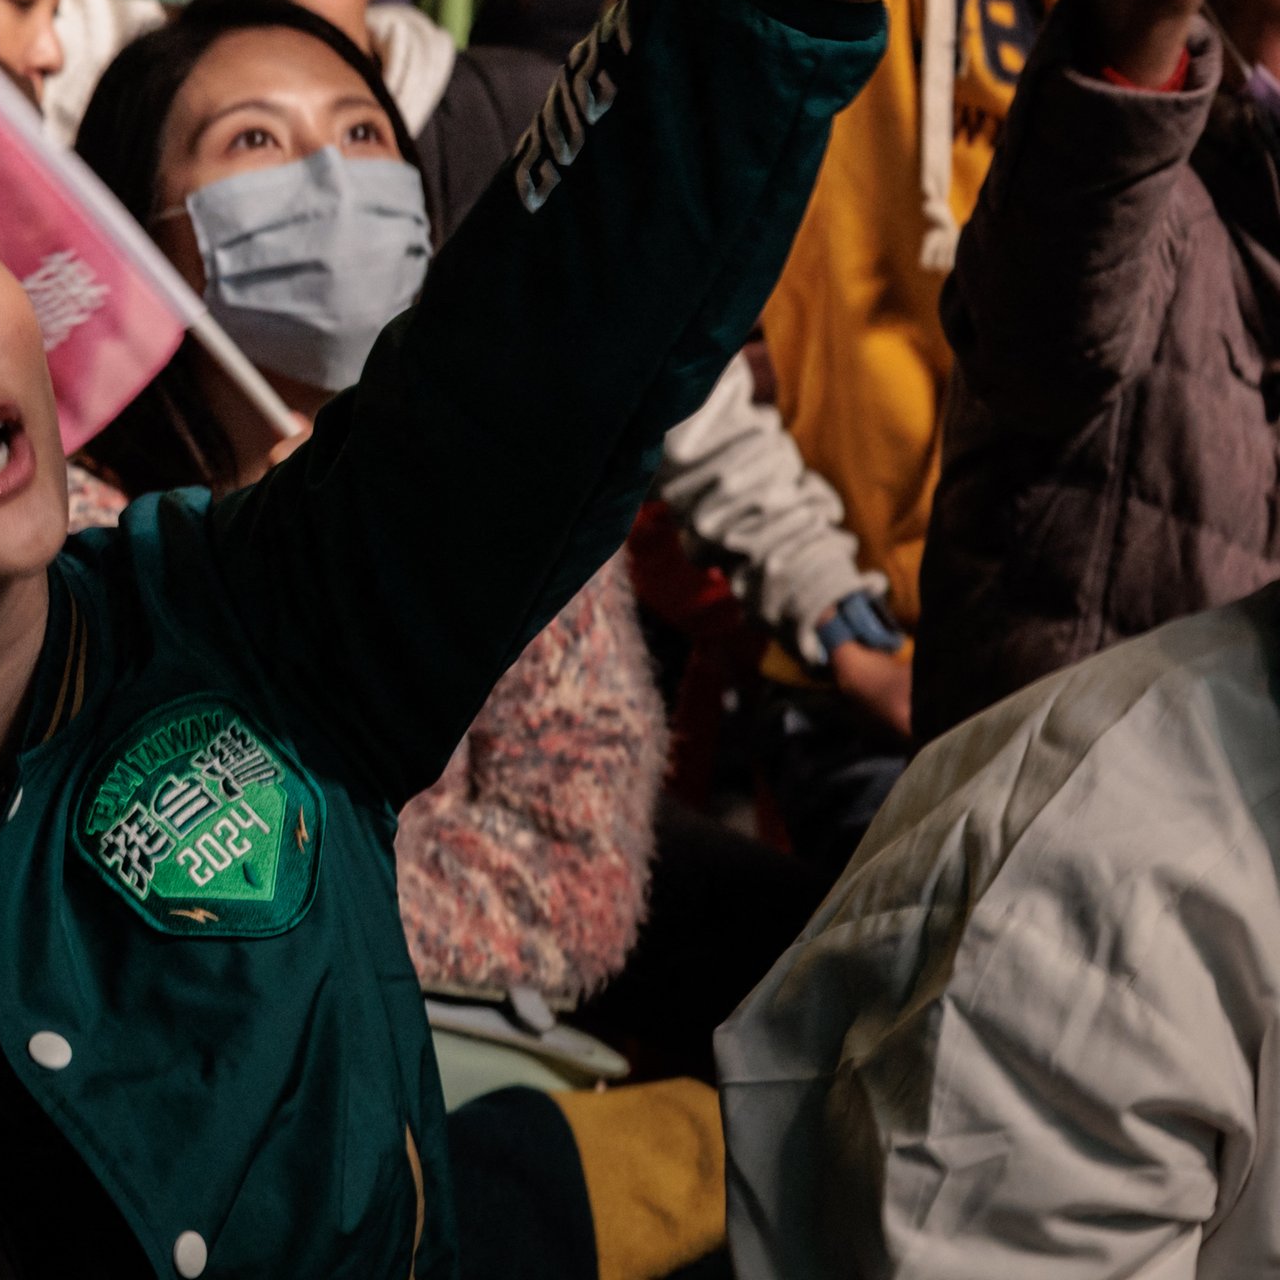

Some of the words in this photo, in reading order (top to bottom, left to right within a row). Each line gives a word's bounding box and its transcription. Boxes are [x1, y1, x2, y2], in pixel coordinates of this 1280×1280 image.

[85, 759, 144, 835] TEAM
[129, 712, 225, 775] TAIWAN
[100, 720, 284, 901] 挺台灣
[177, 801, 271, 887] 2024
